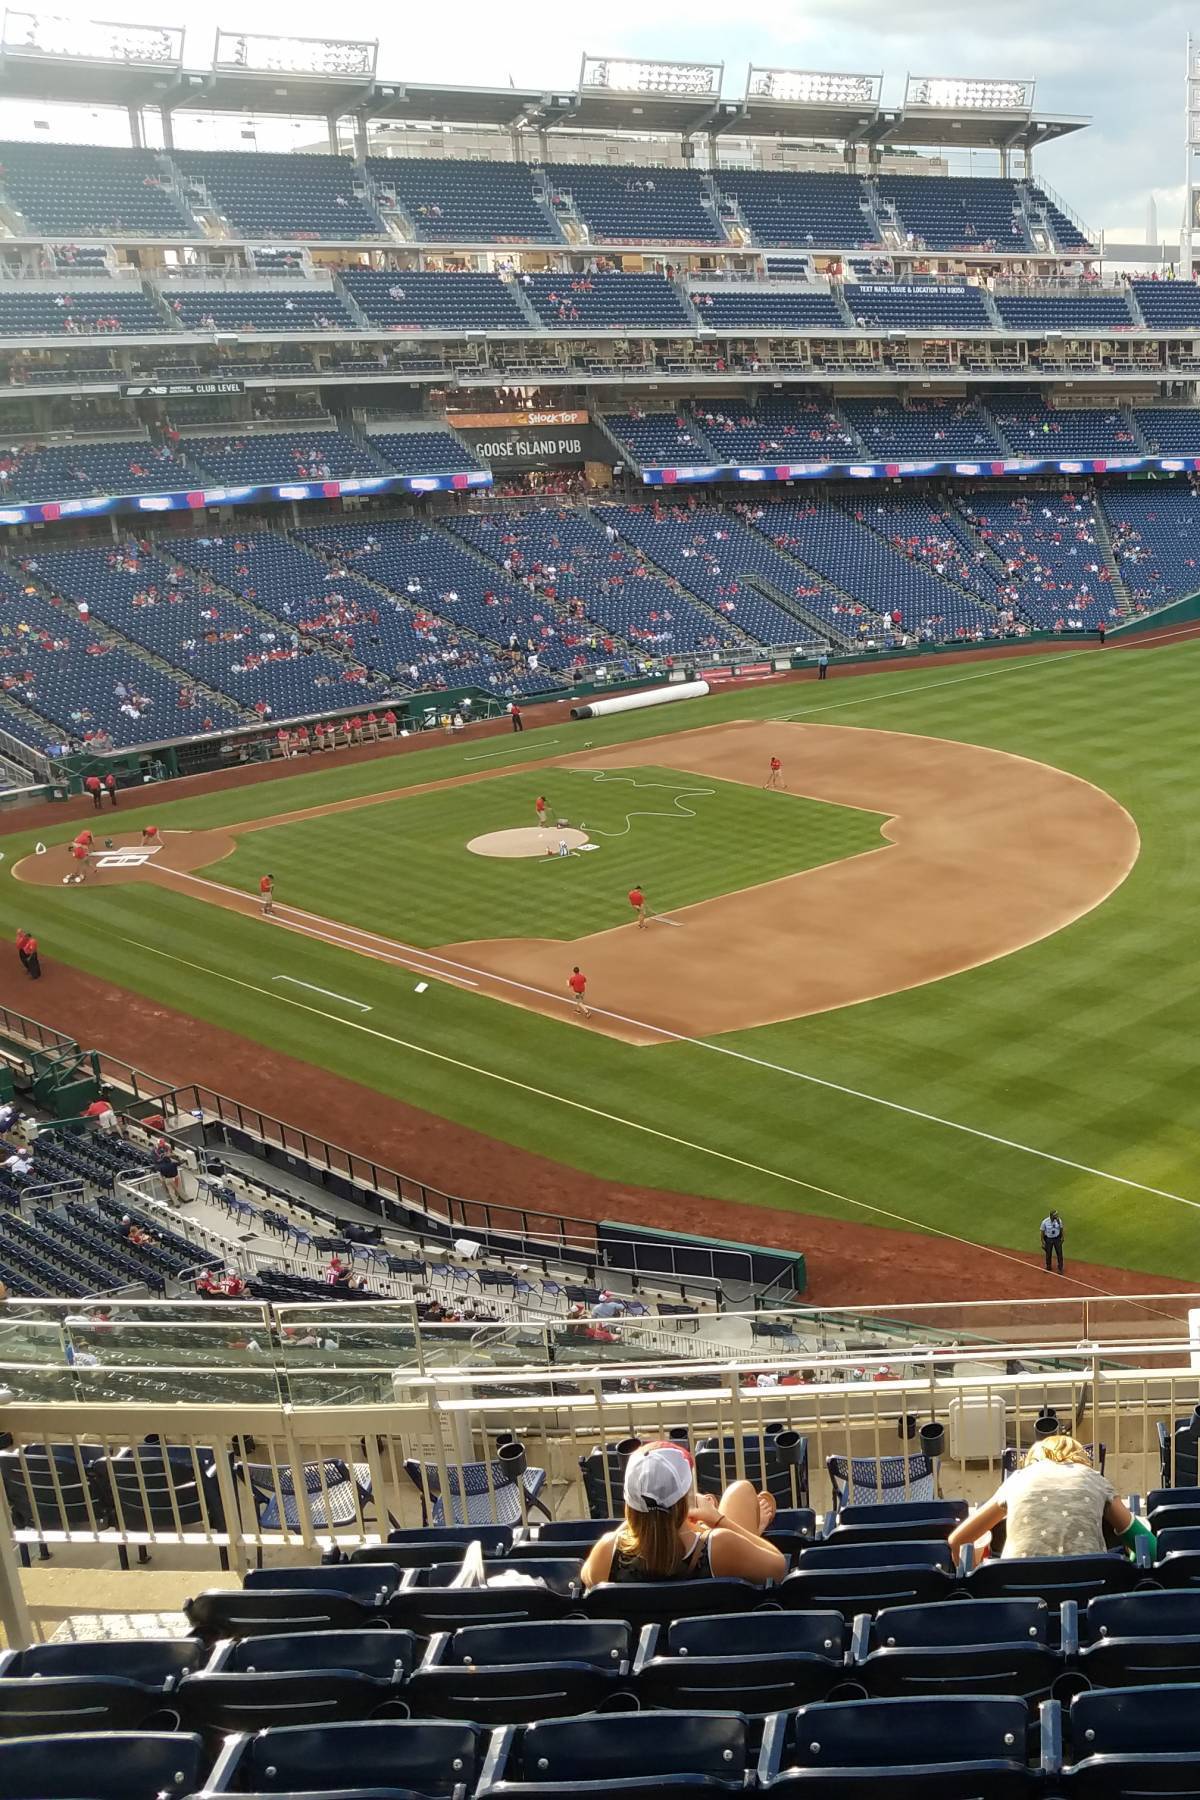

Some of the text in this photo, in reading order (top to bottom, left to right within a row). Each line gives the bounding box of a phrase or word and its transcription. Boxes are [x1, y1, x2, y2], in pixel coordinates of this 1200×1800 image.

[196, 383, 241, 394] CLUB LEVEL
[559, 412, 578, 424] TOP
[476, 440, 582, 457] GOOSE ISLAND PUB
